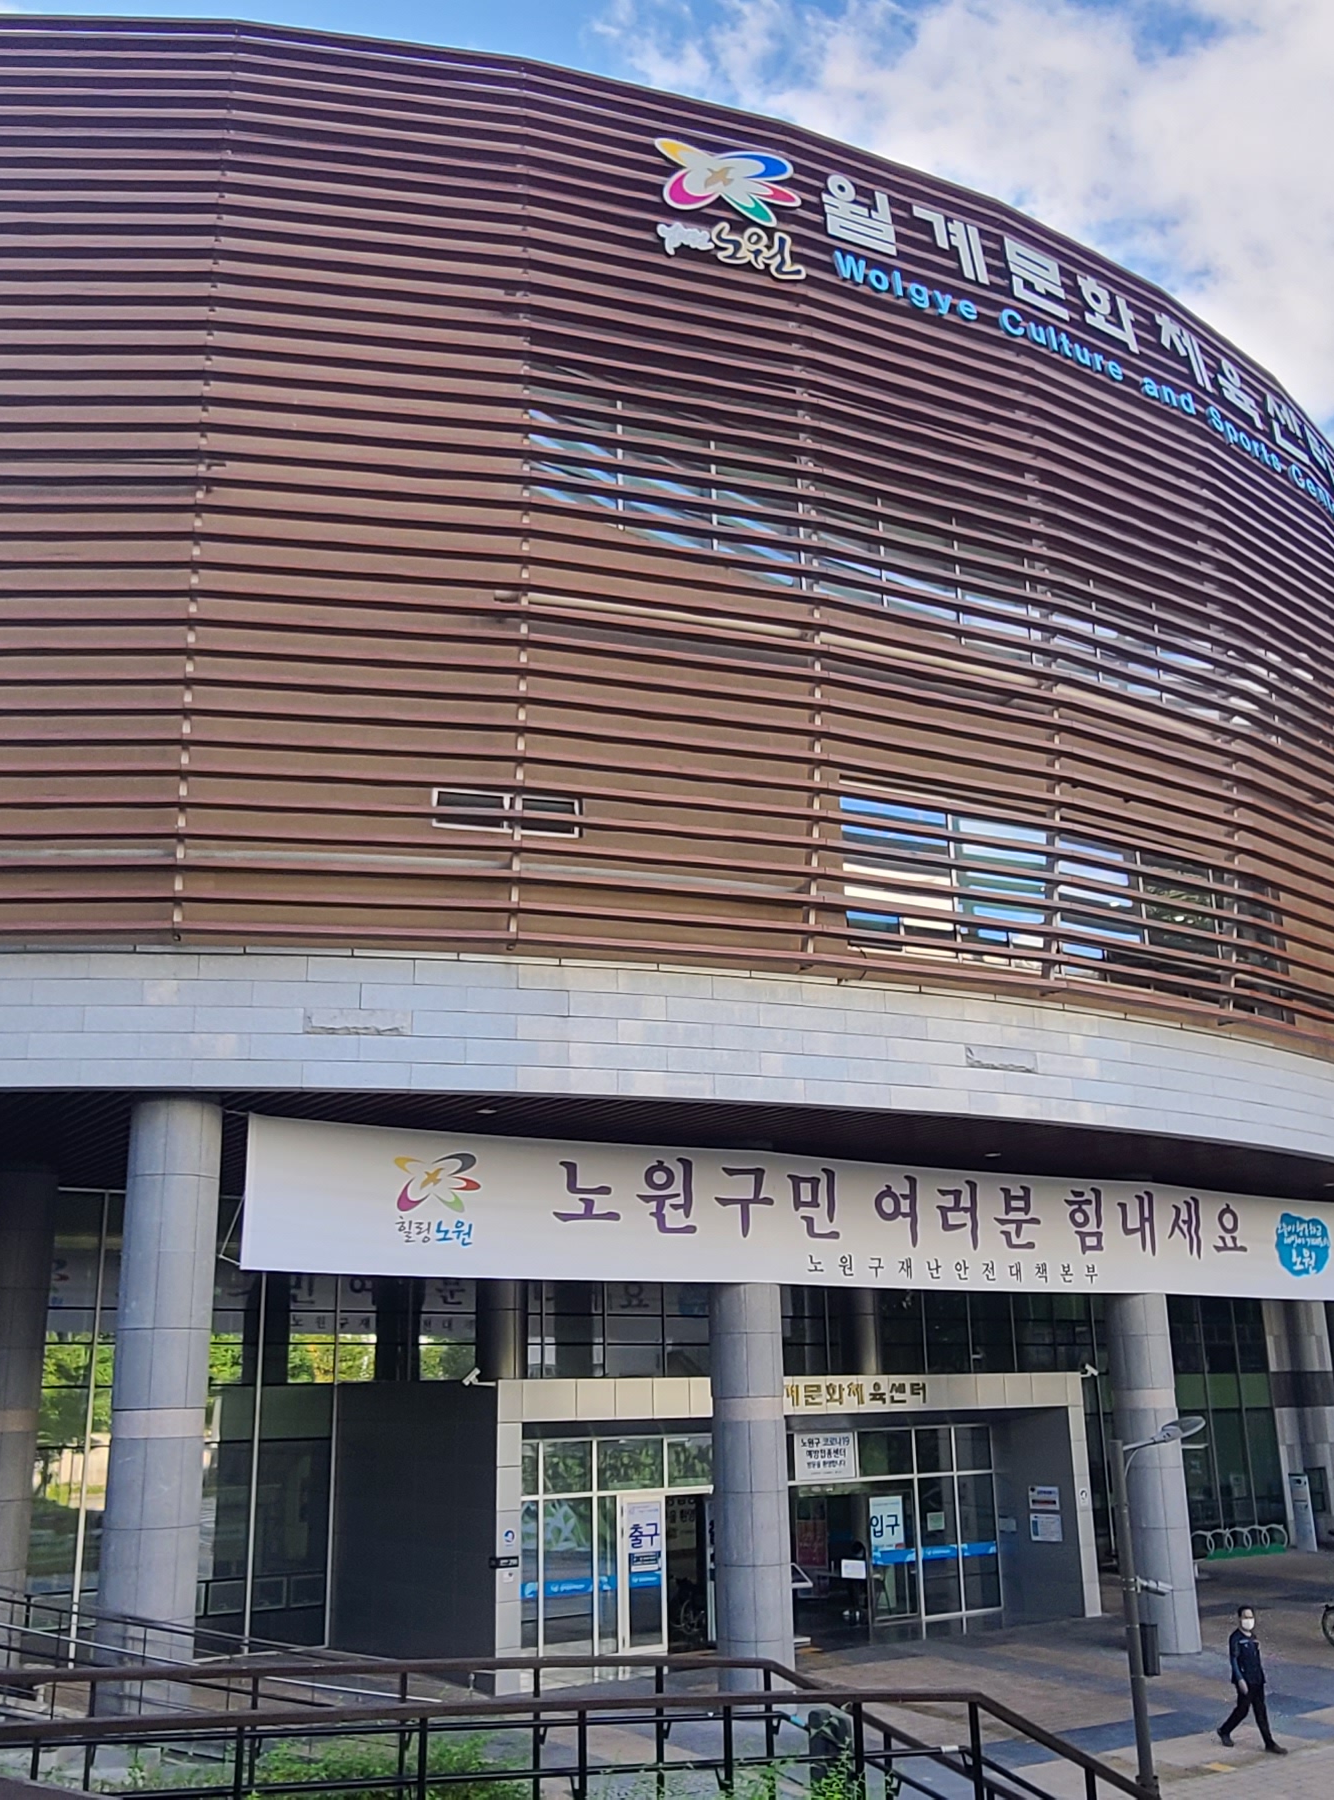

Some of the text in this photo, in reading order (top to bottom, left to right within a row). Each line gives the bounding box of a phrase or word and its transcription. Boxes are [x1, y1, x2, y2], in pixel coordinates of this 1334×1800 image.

[711, 222, 806, 280] 노원
[833, 250, 978, 321] Wolgye
[999, 308, 1125, 382] Culture
[1140, 377, 1196, 416] and
[1204, 406, 1283, 473] Sports
[552, 1157, 1248, 1260] 노원구민 여러분 힘내세요
[395, 1215, 473, 1247] 힐링 노원
[1291, 1248, 1317, 1275] 노원
[784, 1382, 927, 1407] 계문화체육센터
[629, 1523, 660, 1549] 출구
[870, 1514, 900, 1538] 입구
